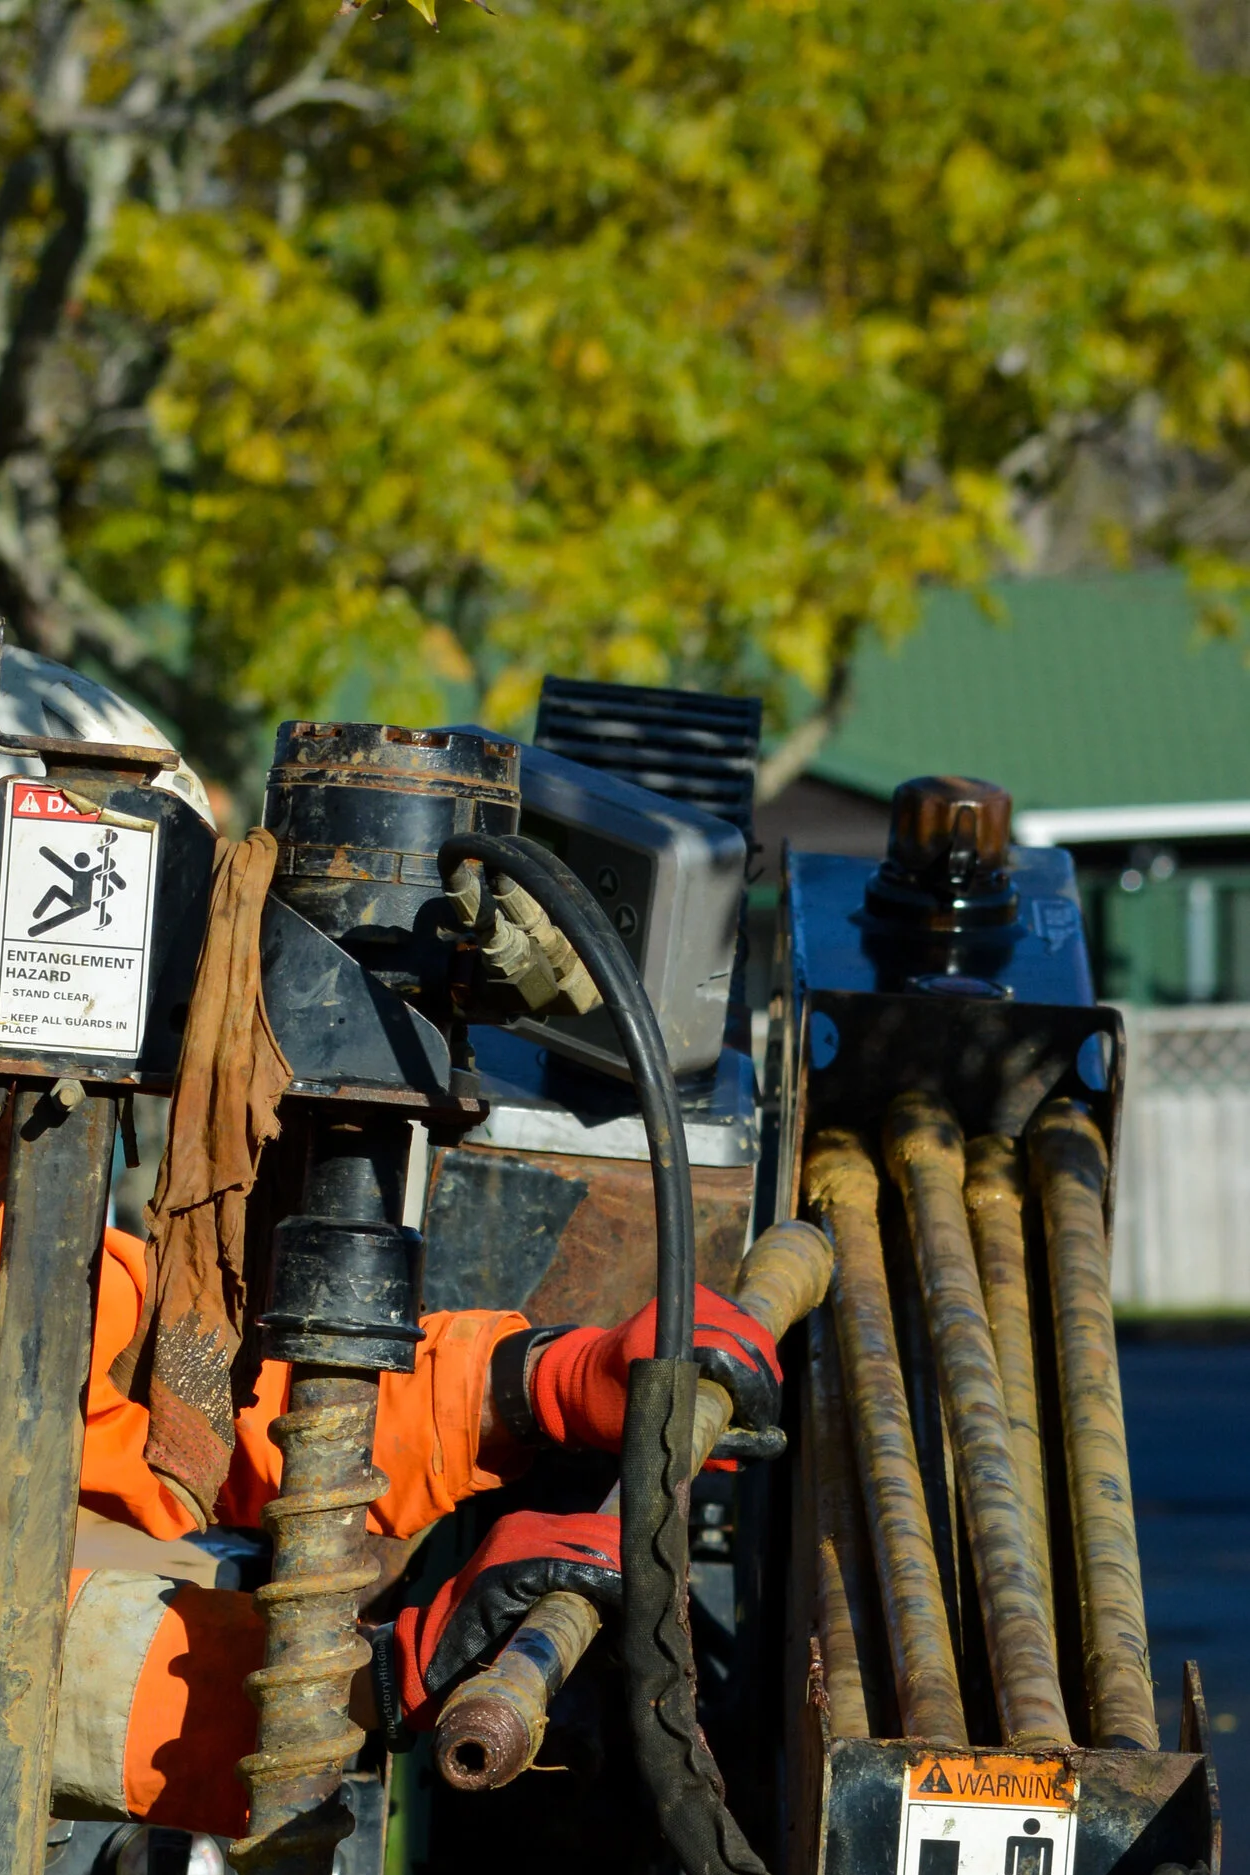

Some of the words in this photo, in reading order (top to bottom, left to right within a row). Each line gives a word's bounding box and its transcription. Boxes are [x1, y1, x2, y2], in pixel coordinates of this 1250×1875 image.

[7, 950, 135, 970] ENTANGLEMENT
[6, 967, 71, 982] HAZARD
[12, 988, 50, 999] STAND
[53, 991, 90, 1002] CLEAR
[10, 1013, 39, 1023] KEEP
[41, 1016, 62, 1025] ALL
[65, 1017, 112, 1029] GUARDS
[115, 1021, 127, 1030] IN
[1, 1025, 38, 1035] PLACE
